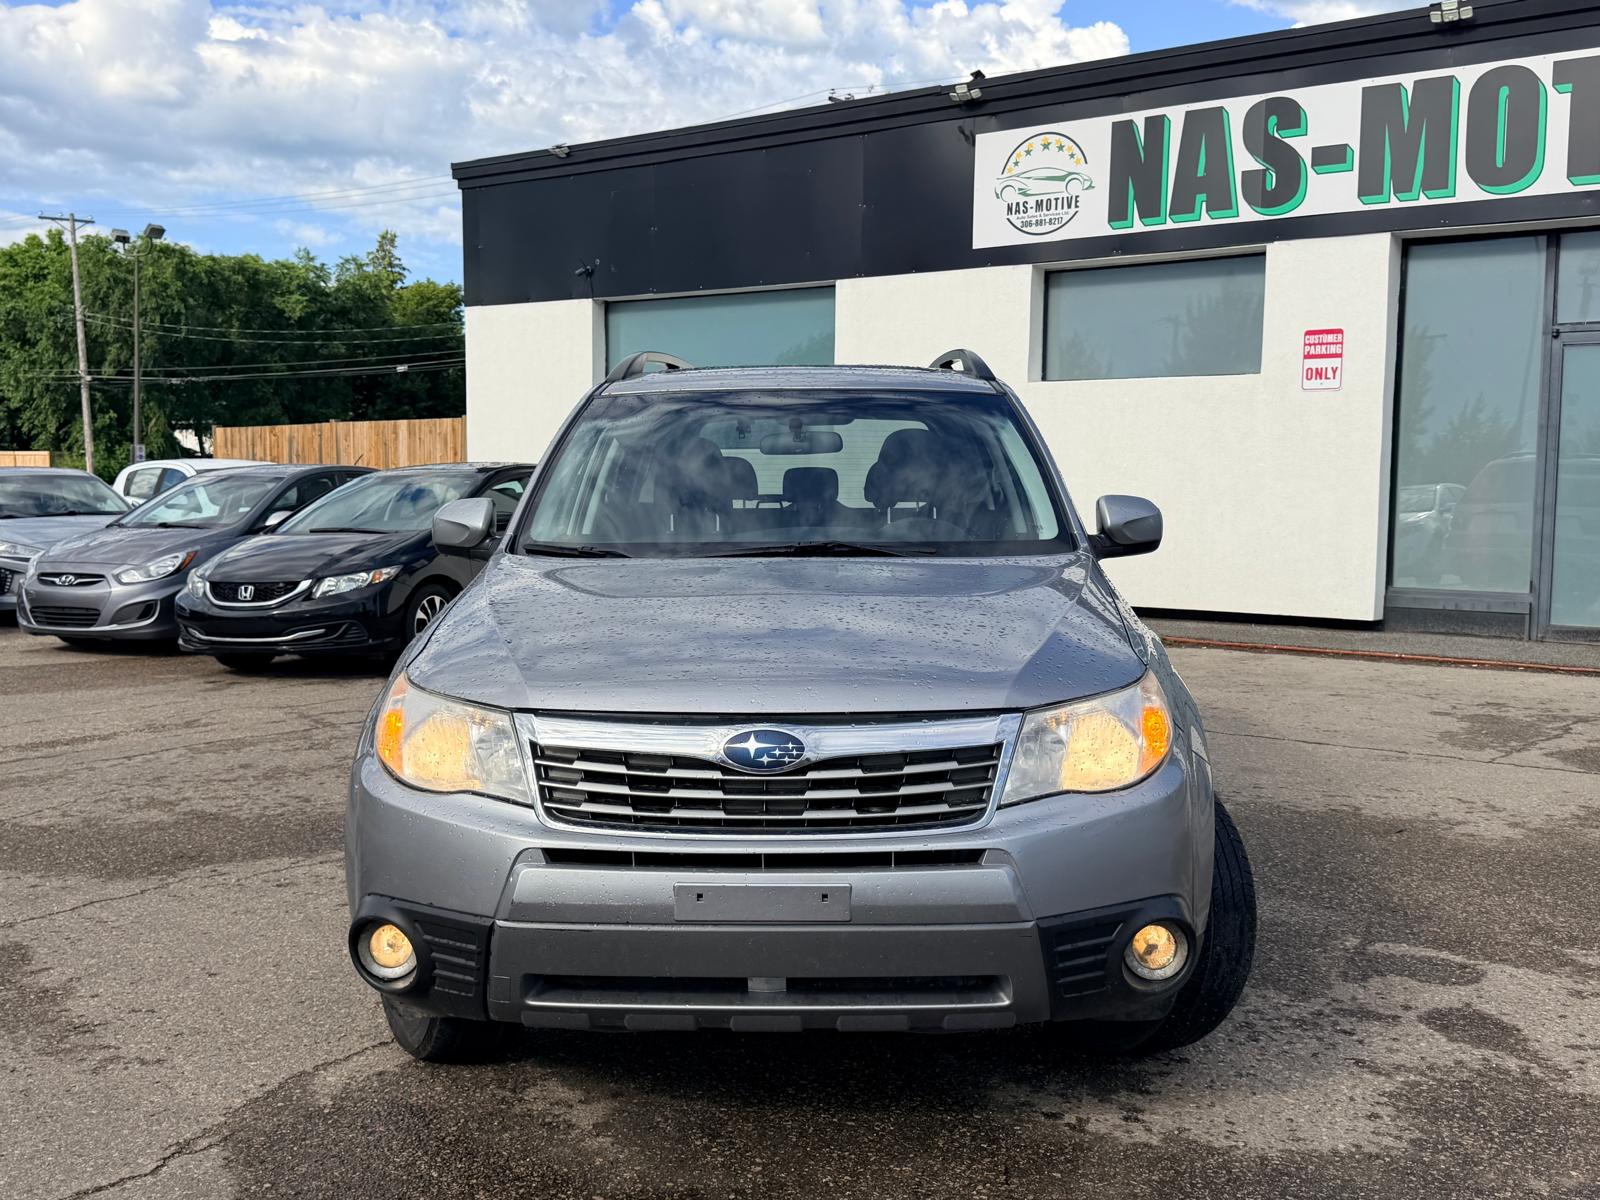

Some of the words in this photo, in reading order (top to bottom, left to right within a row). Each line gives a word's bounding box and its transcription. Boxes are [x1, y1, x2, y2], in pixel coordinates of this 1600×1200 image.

[1006, 194, 1080, 216] NAS-MOTIVE
[1305, 333, 1343, 344] CUSTOMER
[1304, 343, 1342, 355] PARKING
[1305, 366, 1339, 381] ONLY
